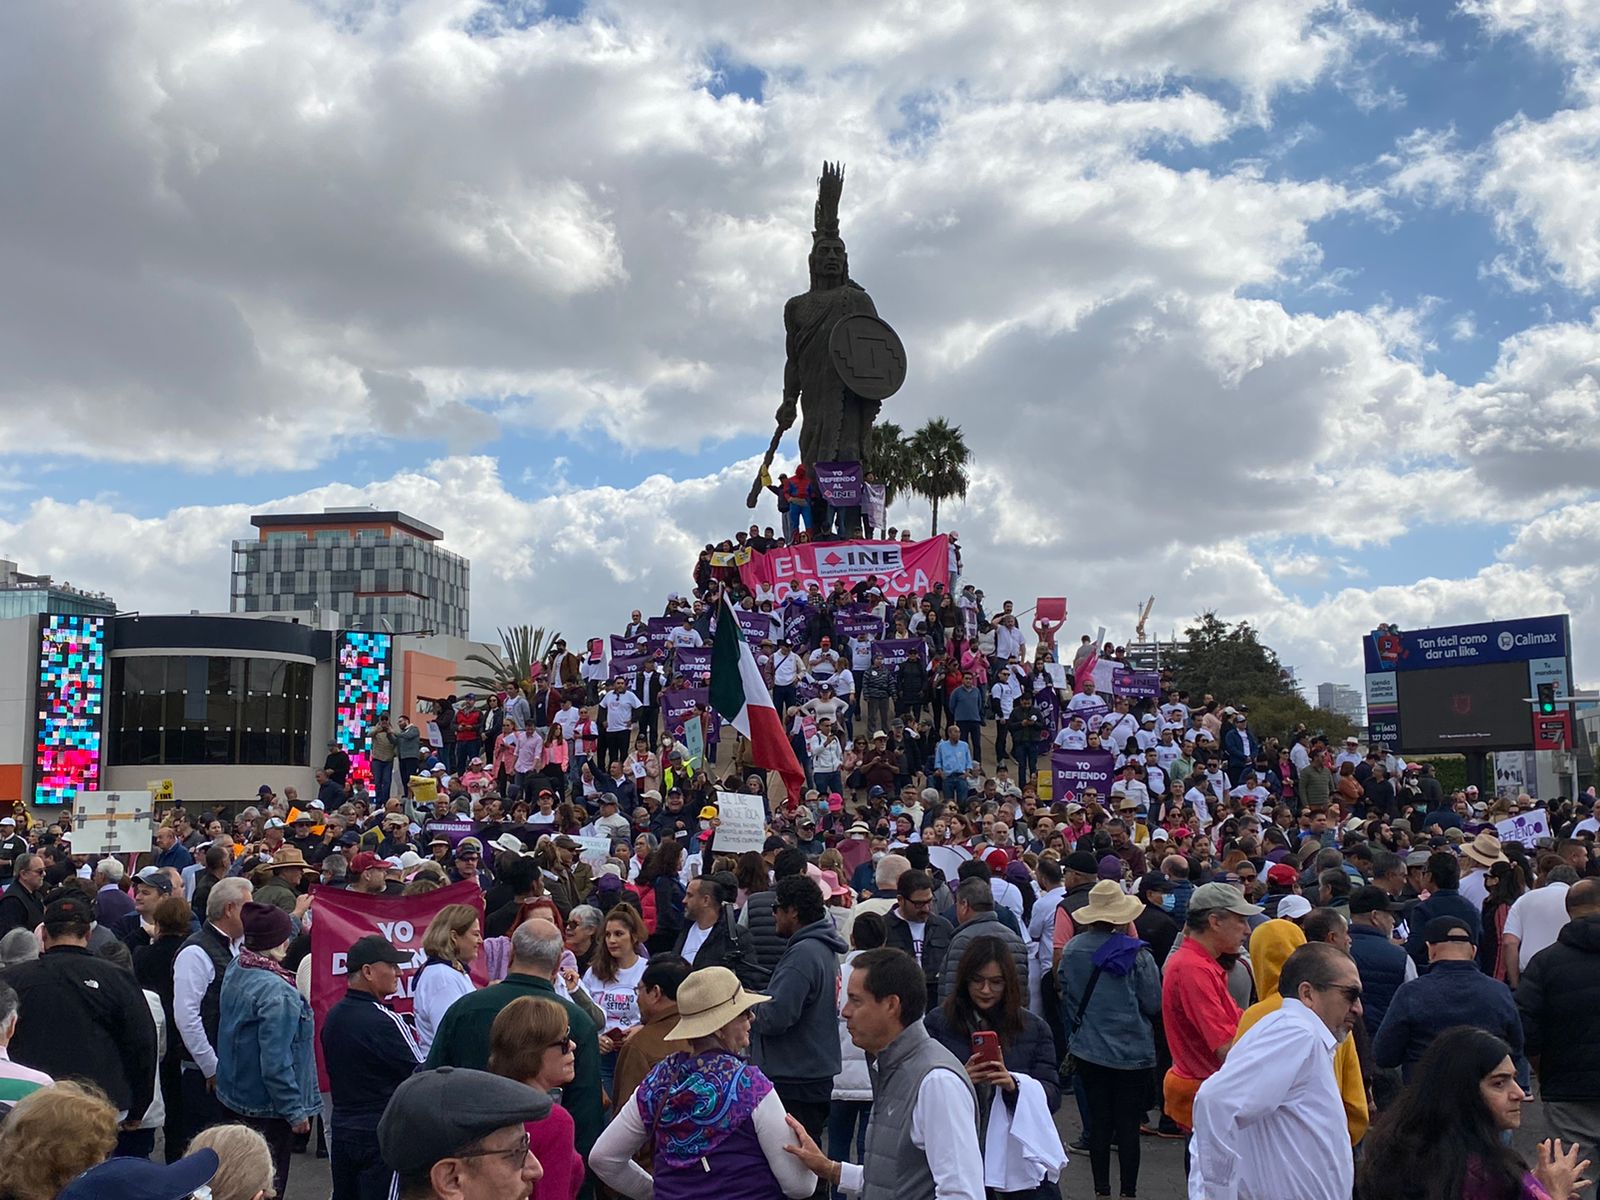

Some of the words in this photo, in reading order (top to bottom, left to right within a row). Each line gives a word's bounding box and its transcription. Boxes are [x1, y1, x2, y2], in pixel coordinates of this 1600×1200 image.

[819, 475, 856, 483] DEFIENDO
[775, 554, 813, 577] EL
[847, 550, 899, 565] INE
[1417, 638, 1436, 649] Tan
[1437, 634, 1458, 647] fácil
[1460, 634, 1488, 645] como
[1514, 632, 1557, 646] Calimax
[1425, 649, 1442, 660] dar
[1444, 648, 1457, 658] un
[1459, 645, 1479, 657] like.
[683, 699, 696, 707] YO
[1076, 761, 1091, 770] YO
[1058, 771, 1107, 780] DEFIENDO
[1512, 816, 1526, 829] YO
[376, 920, 414, 943] YO
[606, 1002, 630, 1010] SETOCA
